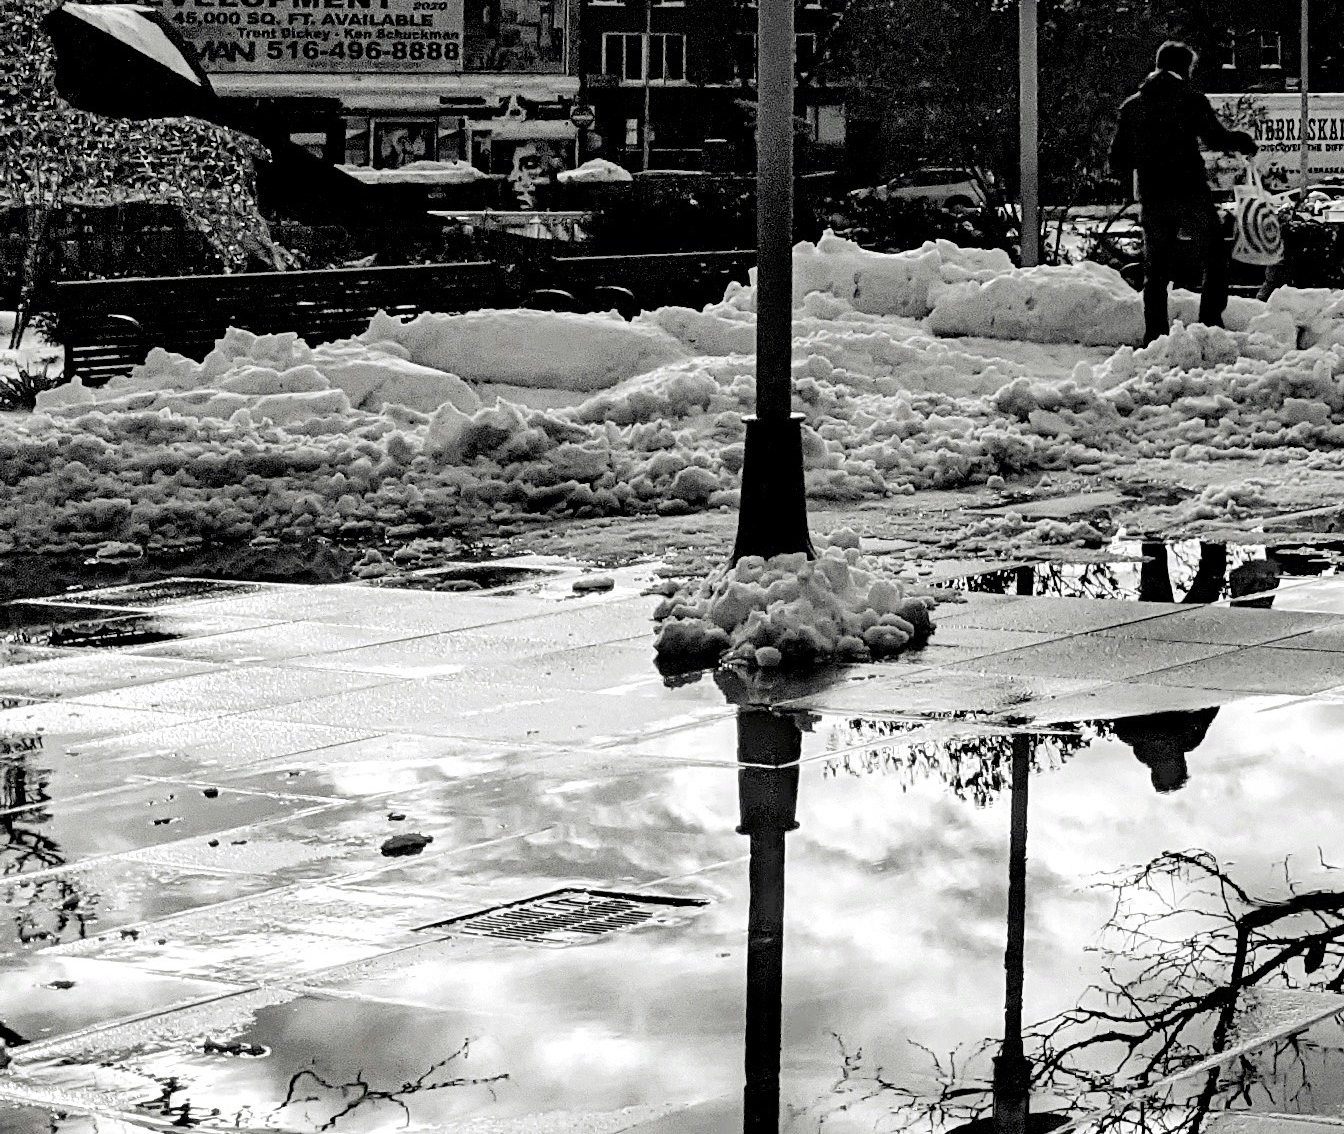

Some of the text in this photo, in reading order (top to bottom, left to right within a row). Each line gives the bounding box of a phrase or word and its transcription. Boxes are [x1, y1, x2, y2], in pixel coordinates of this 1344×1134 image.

[413, 2, 448, 11] 2020
[172, 11, 434, 27] 45,000 SQ. FT. AVAILABLE
[267, 40, 460, 61] 516-496-8888
[1260, 144, 1301, 152] DISCOVE
